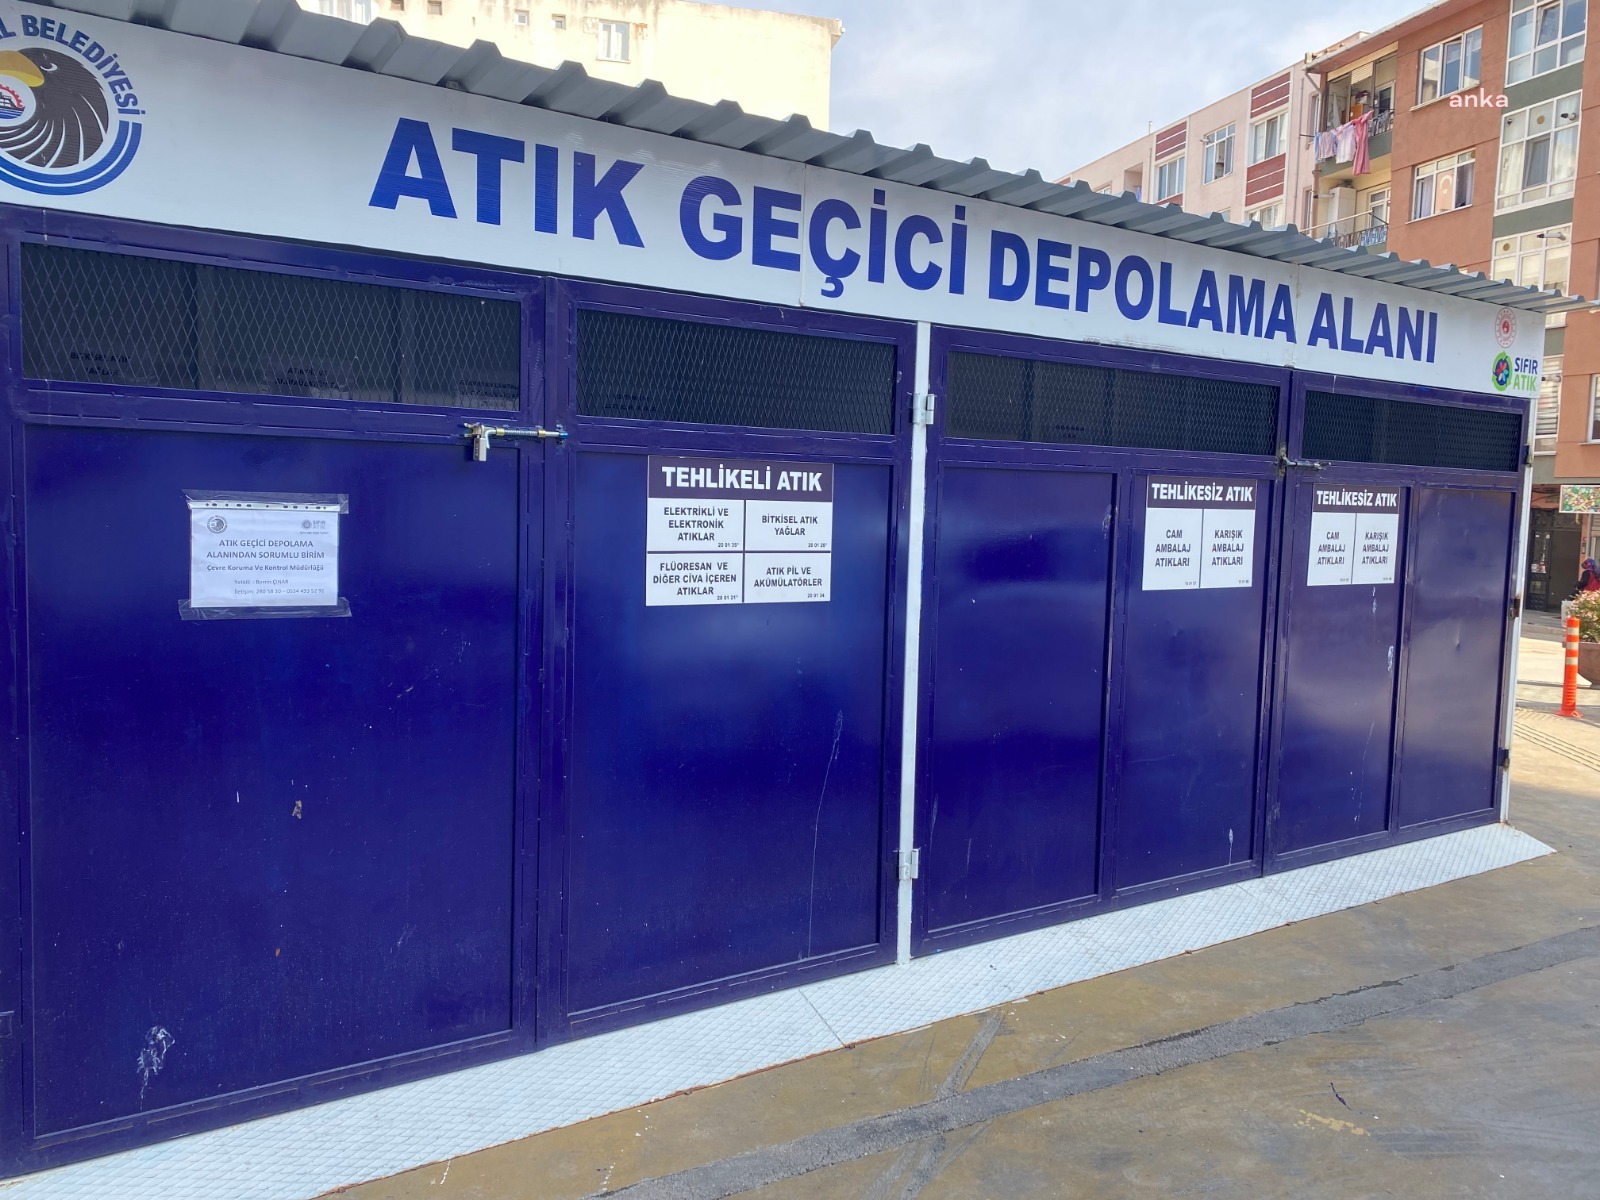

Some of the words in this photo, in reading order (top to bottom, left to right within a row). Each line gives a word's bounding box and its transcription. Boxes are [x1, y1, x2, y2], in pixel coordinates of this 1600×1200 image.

[0, 17, 16, 39] L
[21, 14, 146, 115] BELEDİYESİ
[368, 117, 645, 248] ATIK
[679, 175, 968, 297] GEÇİCİ
[988, 229, 1297, 344] DEPOLAMA
[1307, 291, 1438, 364] ALANI
[1514, 357, 1538, 374] SIFIR
[1513, 373, 1537, 391] ATIK
[661, 464, 771, 490] TEHLİKELİ
[776, 471, 823, 492] ATIK
[1151, 481, 1224, 501] TEHLİKESİZ
[1225, 486, 1254, 501] ATIK
[1316, 488, 1374, 506] TEHLİKESİZ
[1374, 493, 1397, 507] ATIK
[663, 505, 715, 516] ELEKTRİKLİ
[717, 508, 729, 517] VE
[668, 518, 724, 529] ELEKTRONİK
[761, 513, 798, 524] BİTKİSEL
[799, 516, 818, 525] ATIK
[774, 525, 806, 536] YAĞLAR
[1165, 529, 1183, 539] CAM
[1214, 530, 1243, 541] KARIŞIK
[1326, 531, 1340, 540] CAM
[677, 532, 715, 541] ATIKLAR
[1365, 532, 1389, 542] KARIŞIK
[218, 540, 238, 548] ATIK
[239, 539, 266, 549] GEÇİCİ
[268, 540, 314, 548] DEPOLAMA
[1155, 544, 1191, 553] AMBALAJ
[1212, 543, 1244, 553] AMBALAJ
[1318, 544, 1346, 553] AMBALAJ
[1362, 544, 1389, 553] AMBALAJ
[206, 551, 257, 559] ALANINDAN
[258, 551, 300, 559] SORUMLU
[301, 550, 325, 559] BİRİM
[660, 560, 712, 571] FLÜORESAN
[716, 562, 728, 571] VE
[1155, 557, 1190, 567] ATIKLARI
[1211, 556, 1243, 566] ATIKLARI
[1317, 556, 1345, 566] ATIKLARI
[1361, 556, 1388, 565] ATIKLARI
[206, 564, 226, 572] Çevre
[290, 564, 324, 572] Müdürlüğü
[766, 567, 784, 575] ATIK
[787, 565, 800, 575] PİL
[801, 567, 811, 575] VE
[652, 573, 681, 584] DİĞER
[682, 572, 703, 584] CİVA
[705, 572, 737, 585] İÇEREN
[753, 576, 823, 588] AKÜMÜLATÖRLER
[676, 586, 714, 596] ATIKLAR
